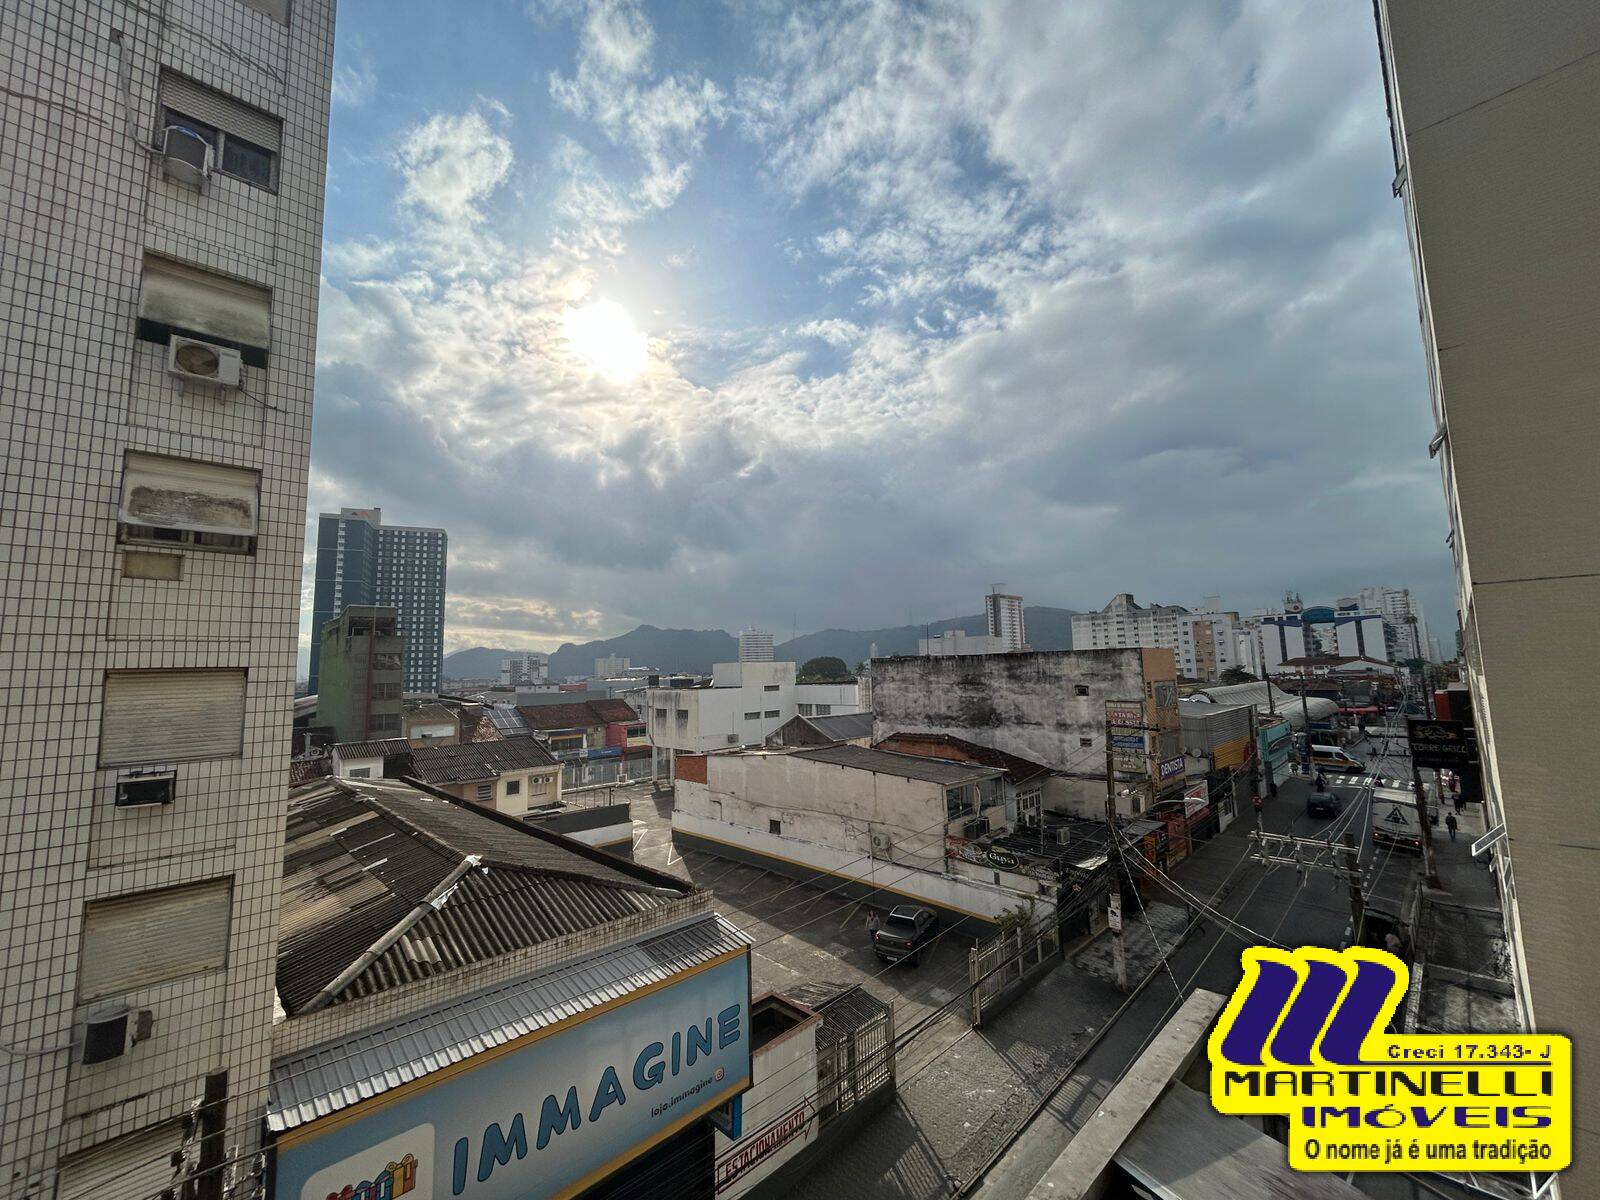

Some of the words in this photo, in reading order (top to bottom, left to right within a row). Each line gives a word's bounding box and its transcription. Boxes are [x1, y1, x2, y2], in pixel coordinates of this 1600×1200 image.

[1161, 757, 1183, 776] DENTISTA
[452, 1003, 741, 1195] IMMAGINE
[650, 1077, 713, 1118] loja.immagine
[725, 1110, 805, 1177] ESTACIONAMENTO
